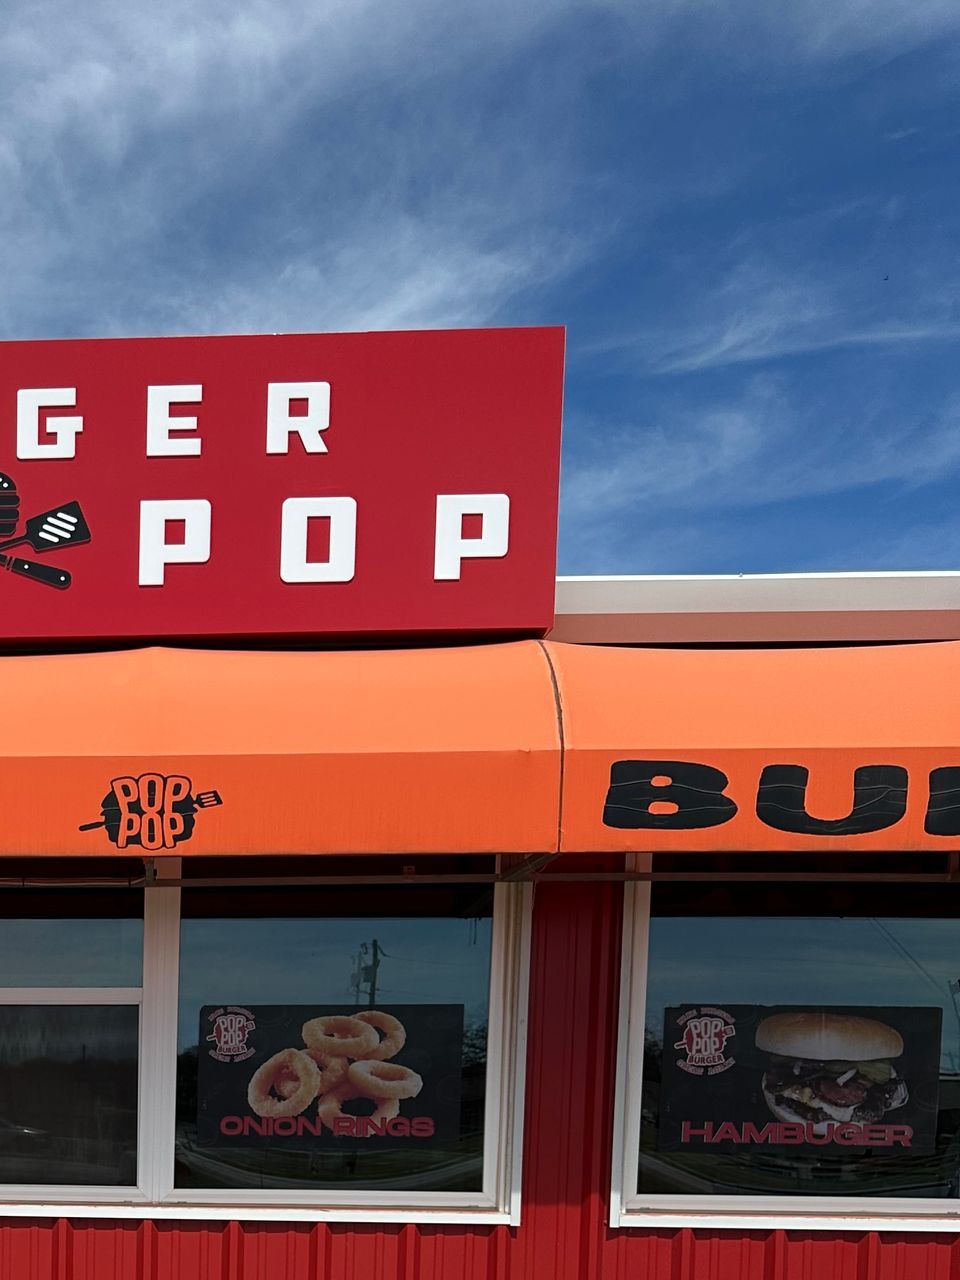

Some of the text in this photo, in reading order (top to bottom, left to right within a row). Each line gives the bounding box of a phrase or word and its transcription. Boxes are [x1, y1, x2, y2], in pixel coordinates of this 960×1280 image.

[138, 493, 510, 586] POP
[110, 772, 192, 813] POP
[116, 811, 185, 850] POP
[218, 1016, 244, 1032] POP
[688, 1019, 721, 1038] POP
[220, 1031, 243, 1046] POP
[691, 1037, 720, 1055] POP
[688, 1054, 724, 1064] BURGER
[220, 1115, 435, 1137] ONION RINGS
[681, 1120, 914, 1147] HAMBUGER
